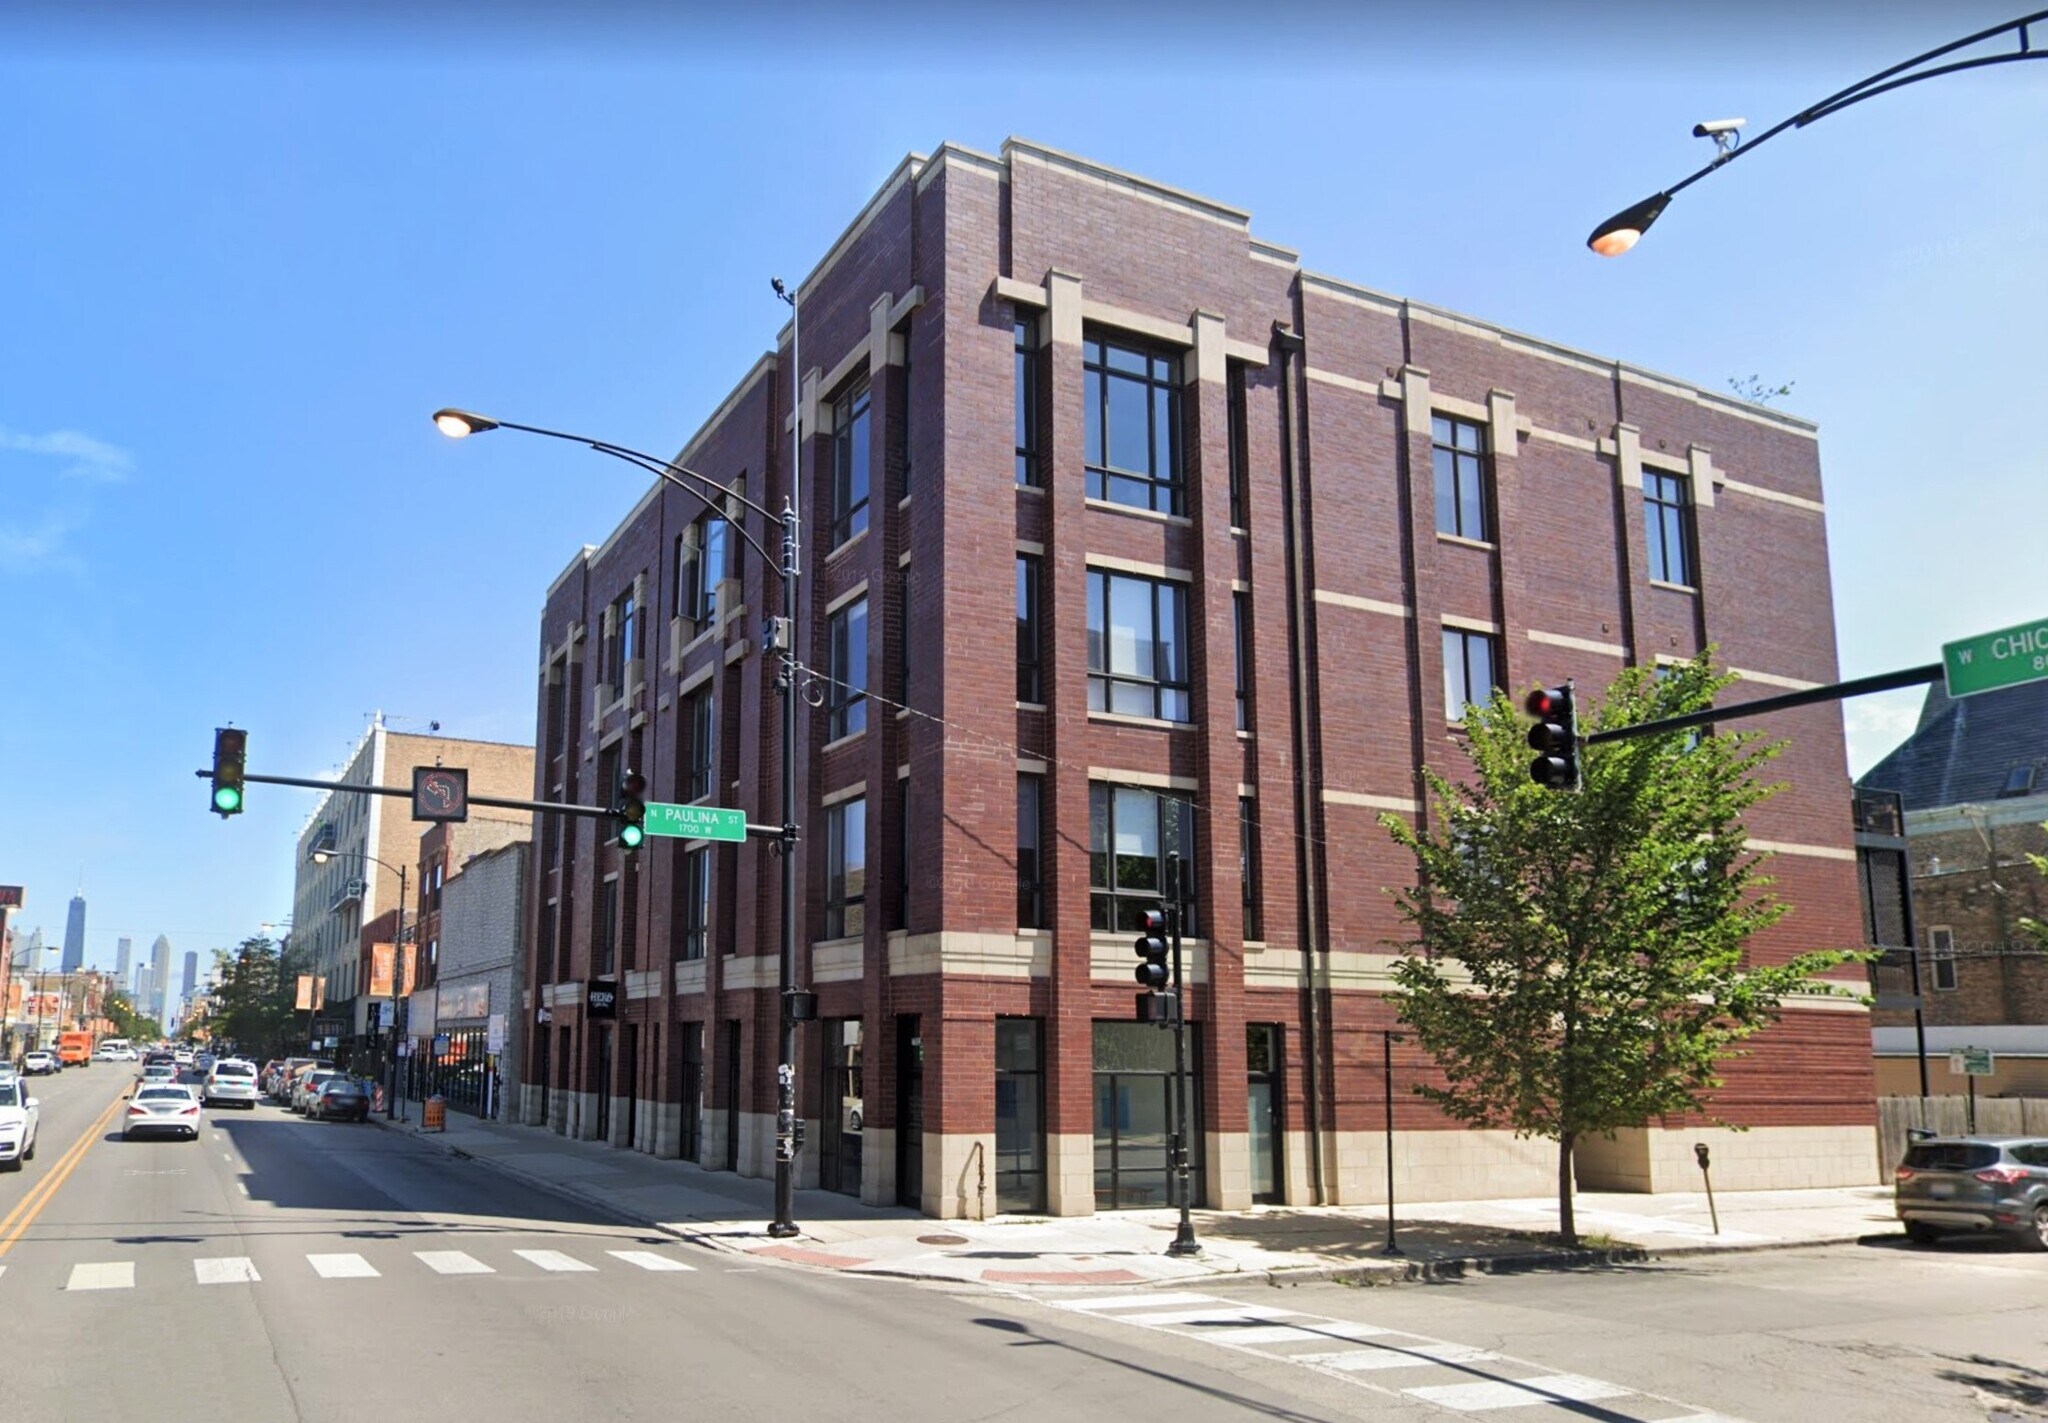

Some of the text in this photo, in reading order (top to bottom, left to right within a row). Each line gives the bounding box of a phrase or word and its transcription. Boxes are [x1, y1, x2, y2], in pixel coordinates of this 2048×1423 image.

[1959, 649, 1972, 665] W
[650, 808, 739, 824] N PAULINA ST
[679, 823, 713, 834] 1700 W
